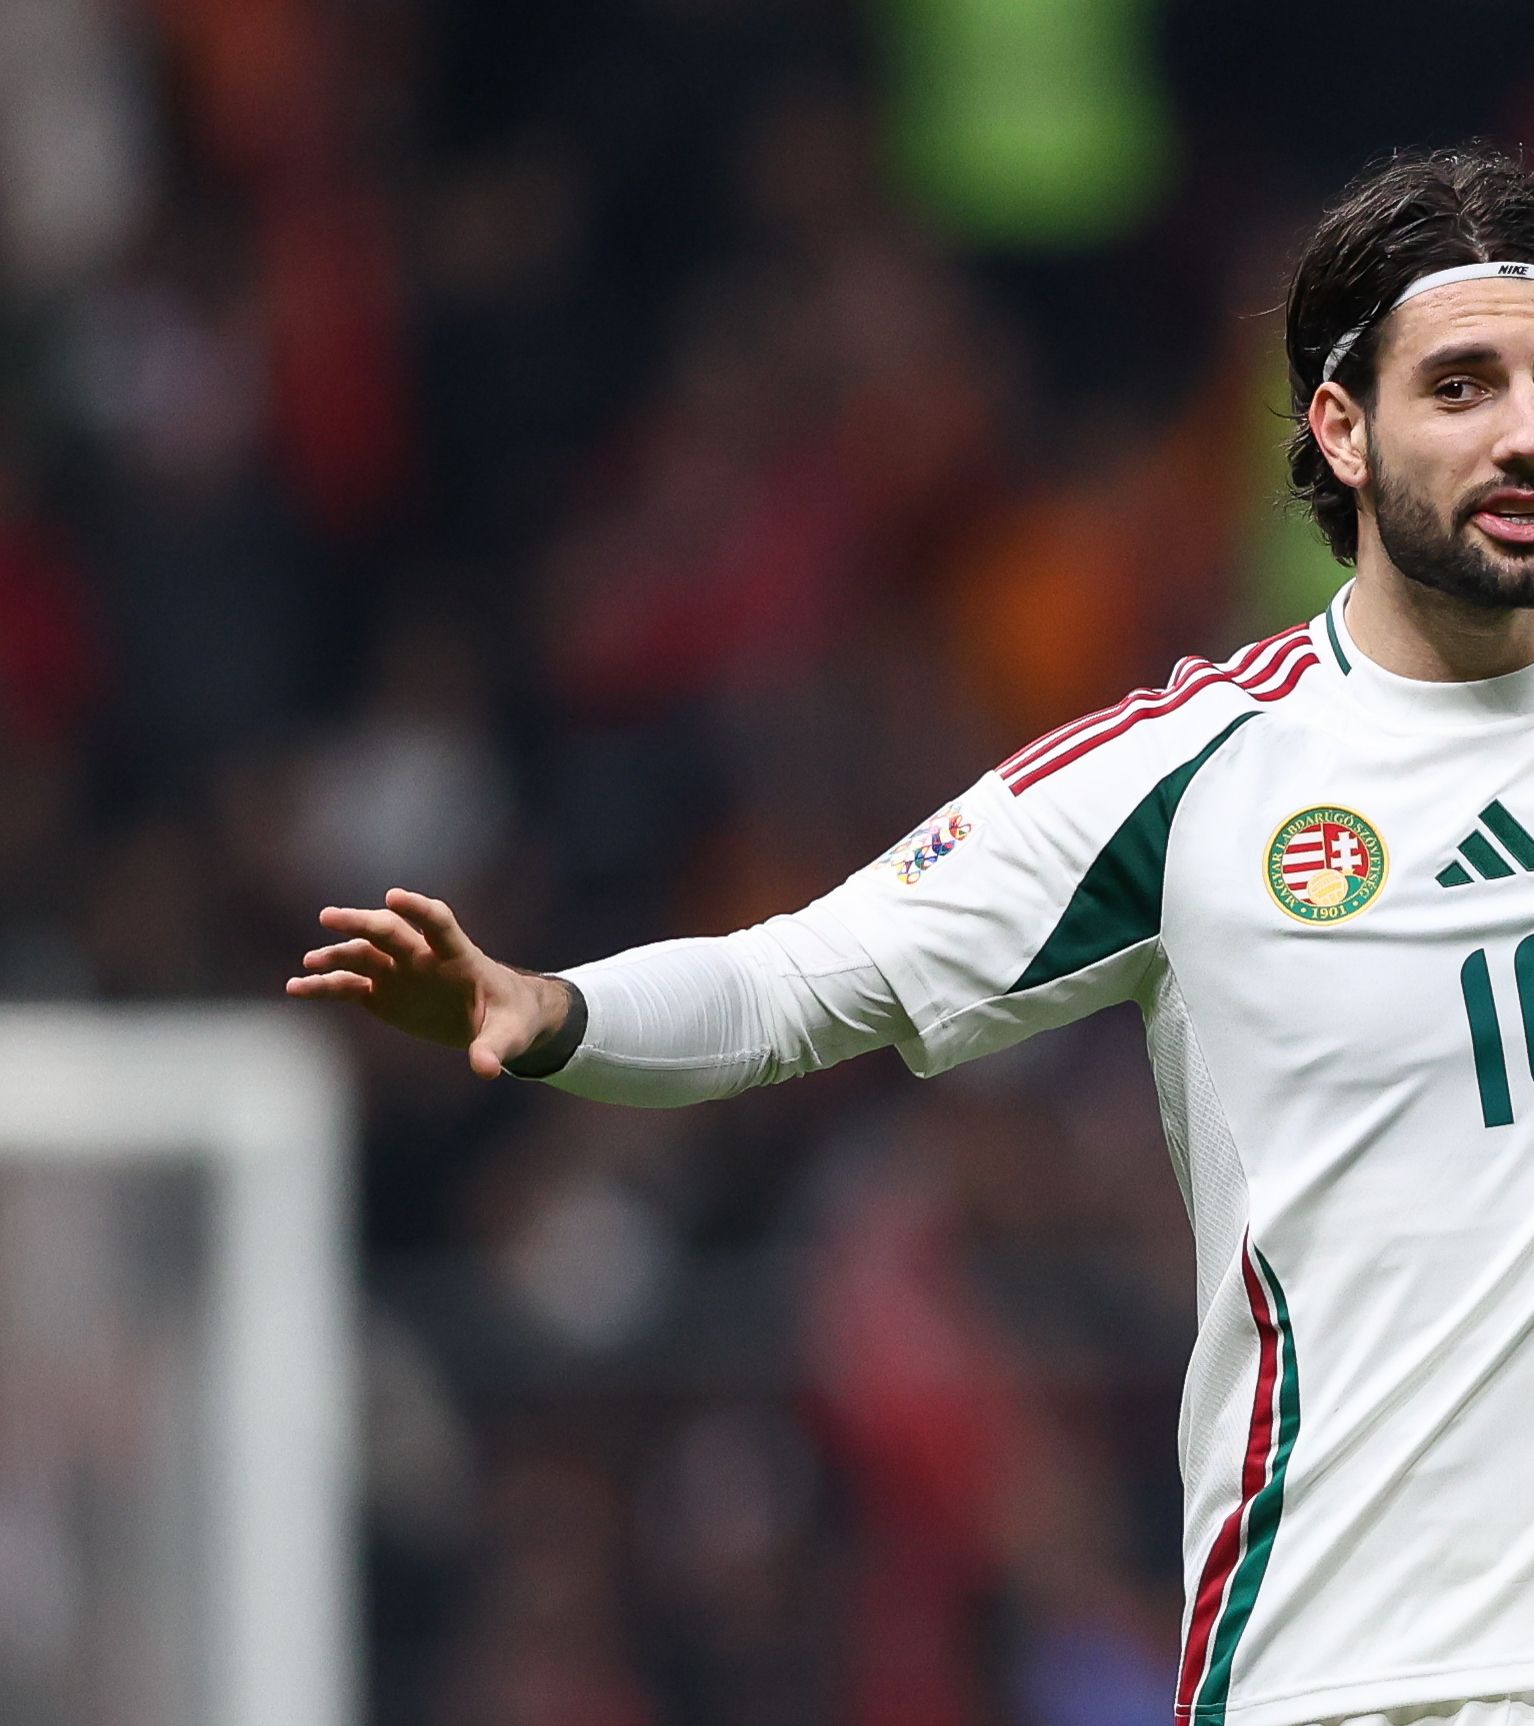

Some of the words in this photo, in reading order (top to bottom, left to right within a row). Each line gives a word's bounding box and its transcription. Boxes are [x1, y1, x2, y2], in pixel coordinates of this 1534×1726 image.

[1498, 264, 1529, 275] NIKE
[1271, 852, 1298, 908] MAGYAR
[1311, 904, 1347, 919] 1901
